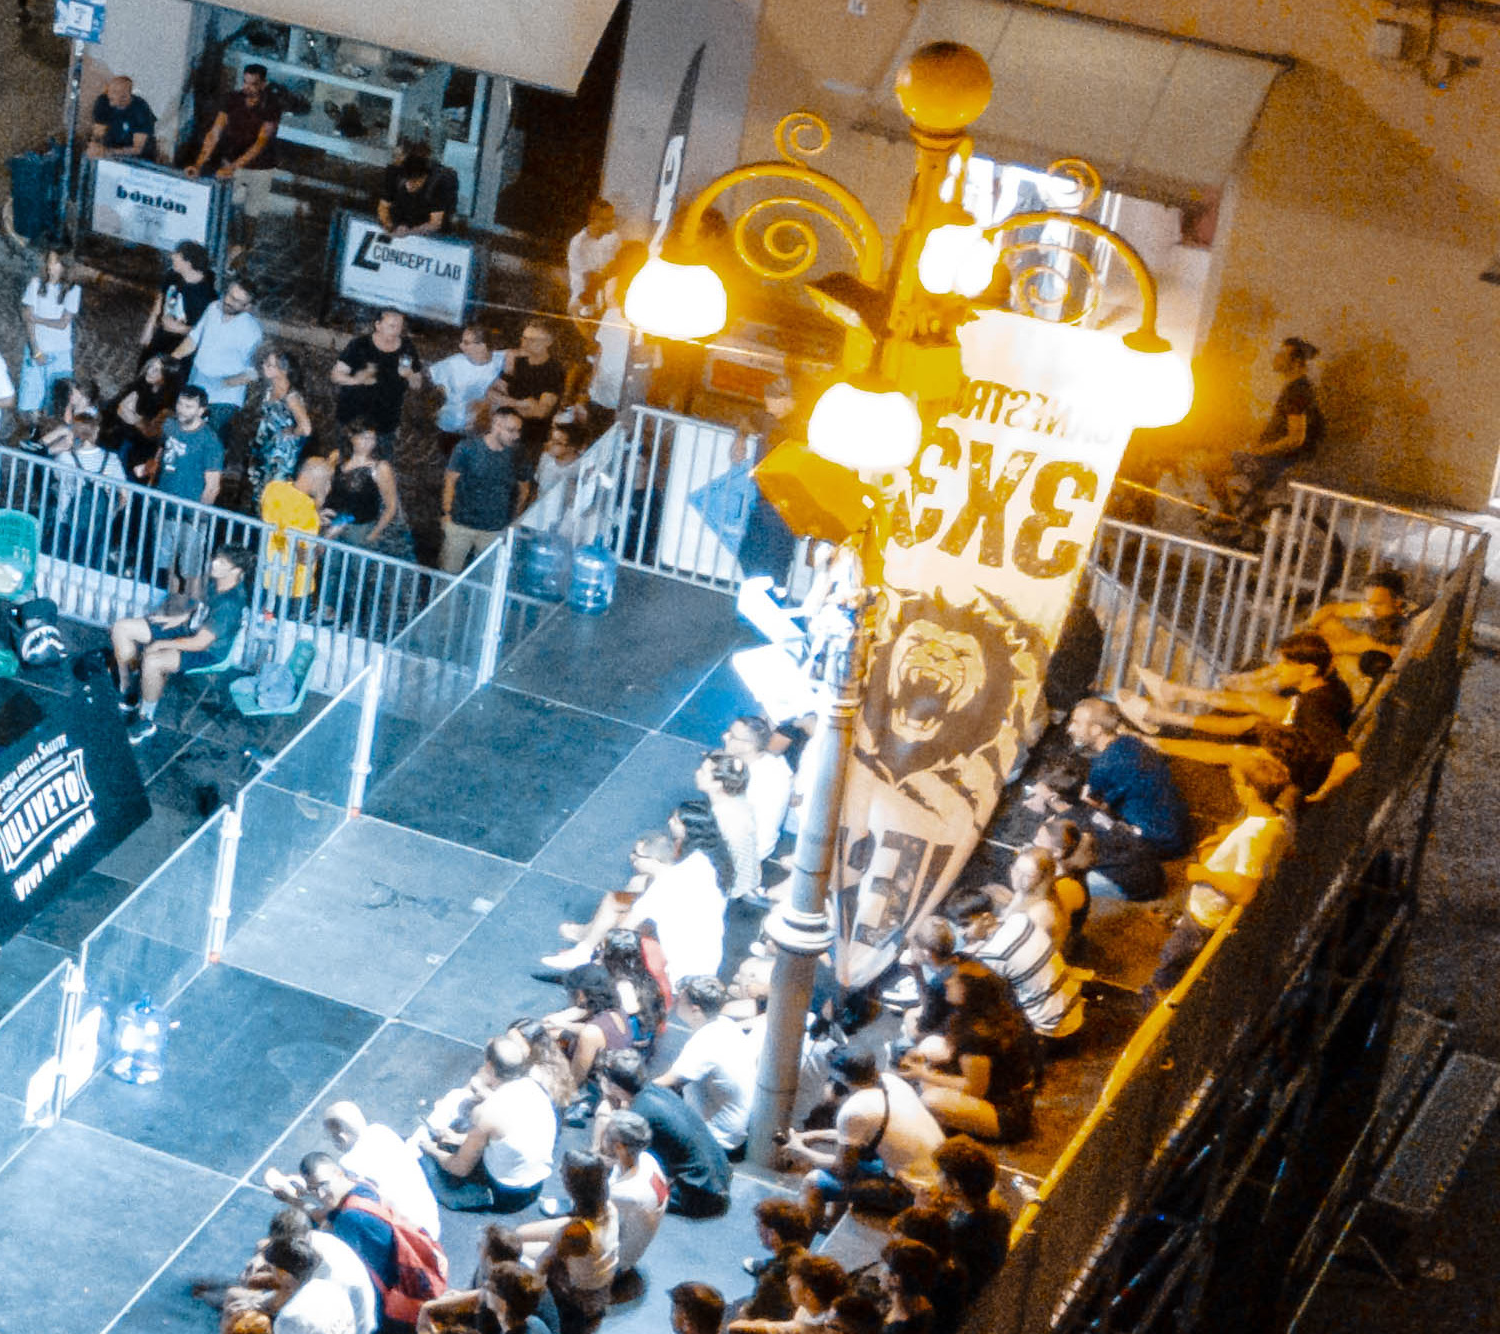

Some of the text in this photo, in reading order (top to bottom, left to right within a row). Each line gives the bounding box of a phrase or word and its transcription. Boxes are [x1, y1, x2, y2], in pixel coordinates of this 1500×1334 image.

[372, 243, 462, 281] CONCEPT LAB
[1, 769, 81, 855] ULIVETO
